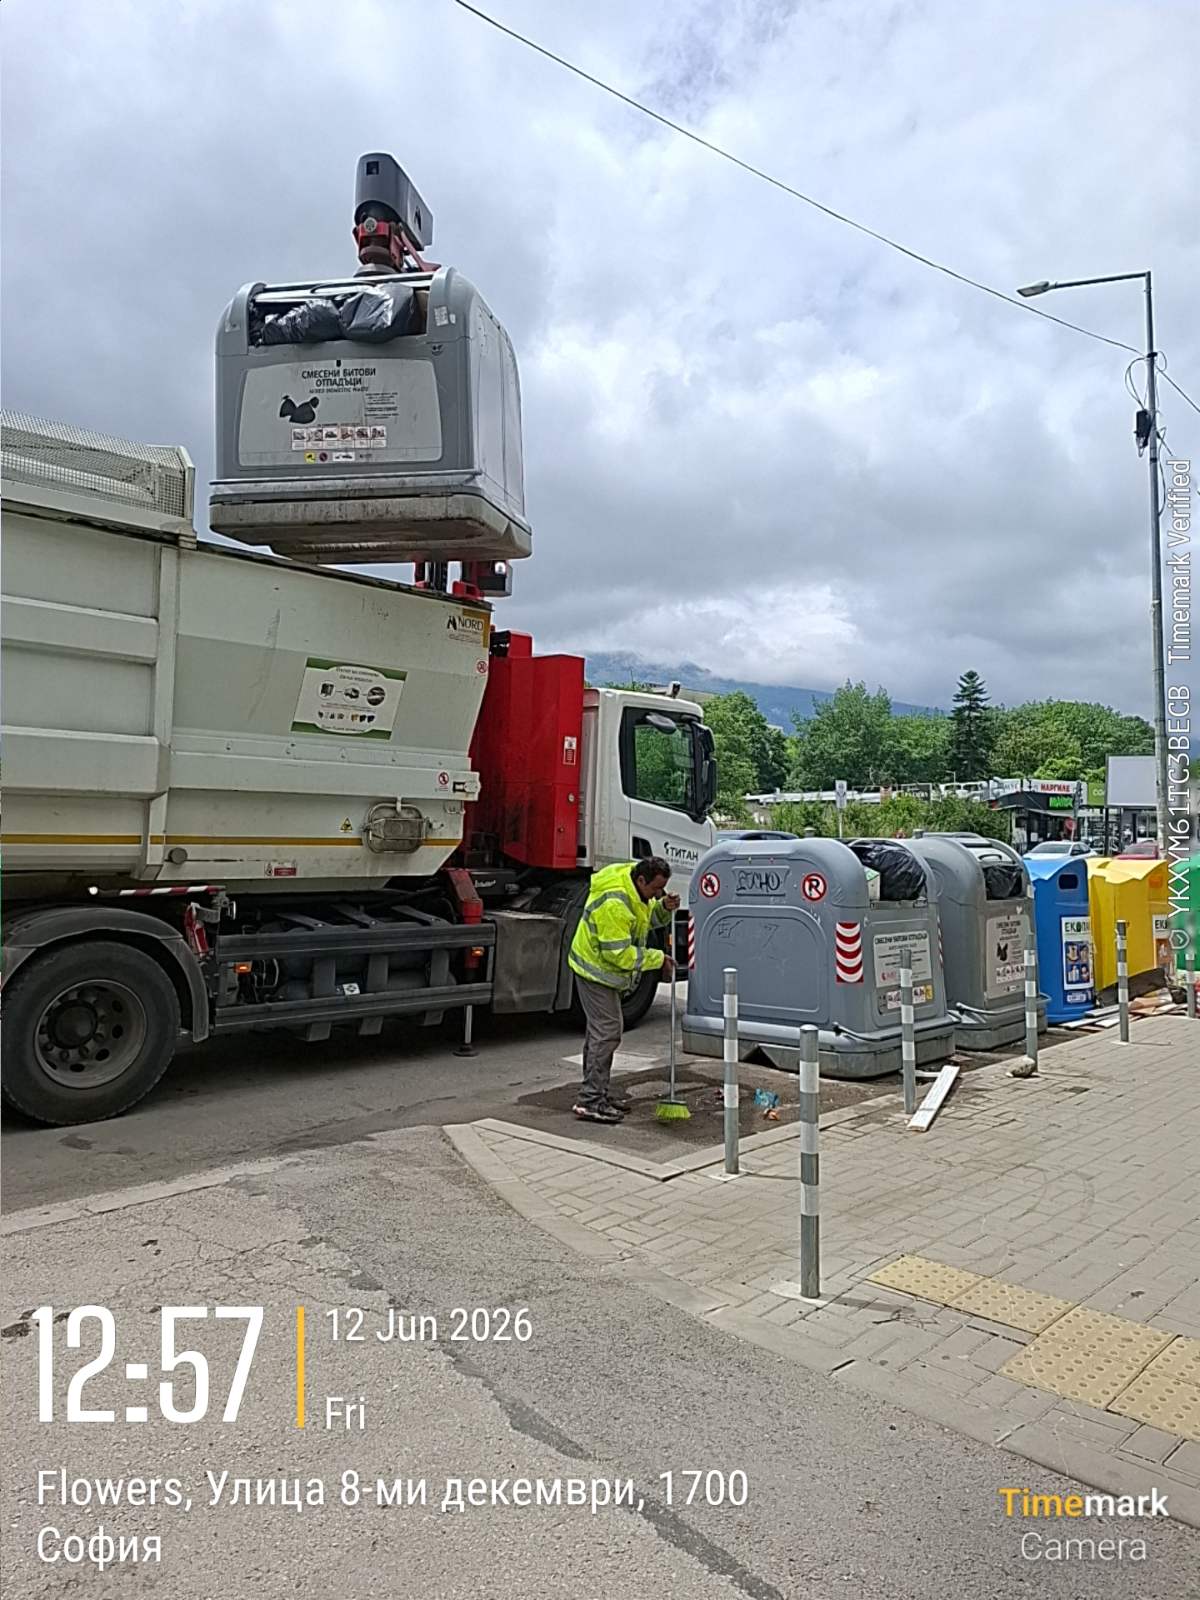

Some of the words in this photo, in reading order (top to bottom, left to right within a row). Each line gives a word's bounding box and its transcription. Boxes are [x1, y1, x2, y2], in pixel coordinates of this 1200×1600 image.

[301, 369, 340, 379] СМЕСЕНИ
[343, 367, 376, 377] БИТОВИ
[315, 377, 362, 387] ОТПАДЪЦИ
[458, 616, 484, 631] NORD
[670, 846, 698, 861] ТИТАН
